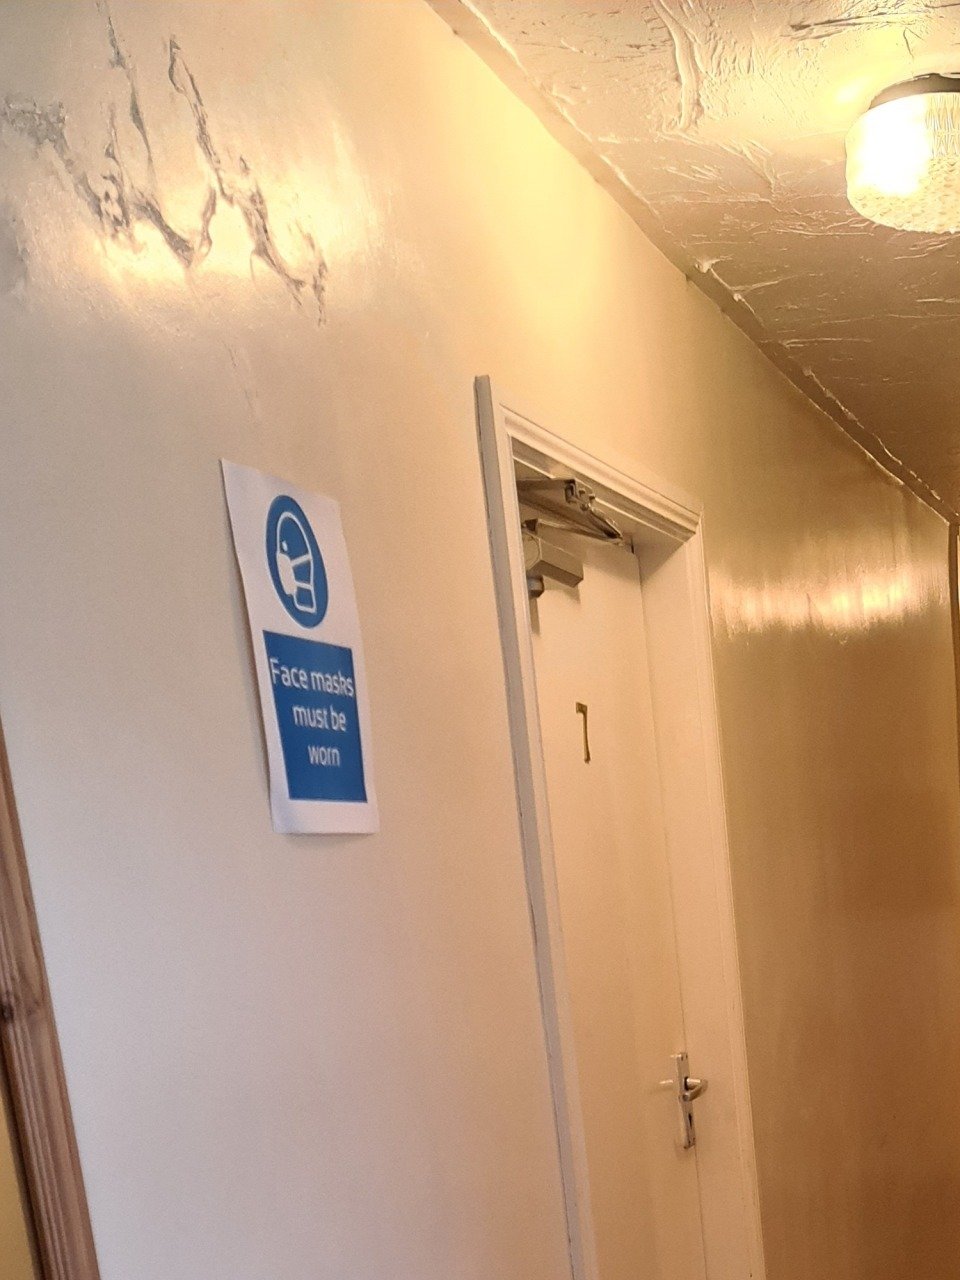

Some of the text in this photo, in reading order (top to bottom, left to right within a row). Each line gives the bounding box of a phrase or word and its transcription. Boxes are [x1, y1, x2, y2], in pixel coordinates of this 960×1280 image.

[270, 657, 354, 697] Face masks
[292, 704, 346, 732] must be
[308, 744, 341, 767] worn
